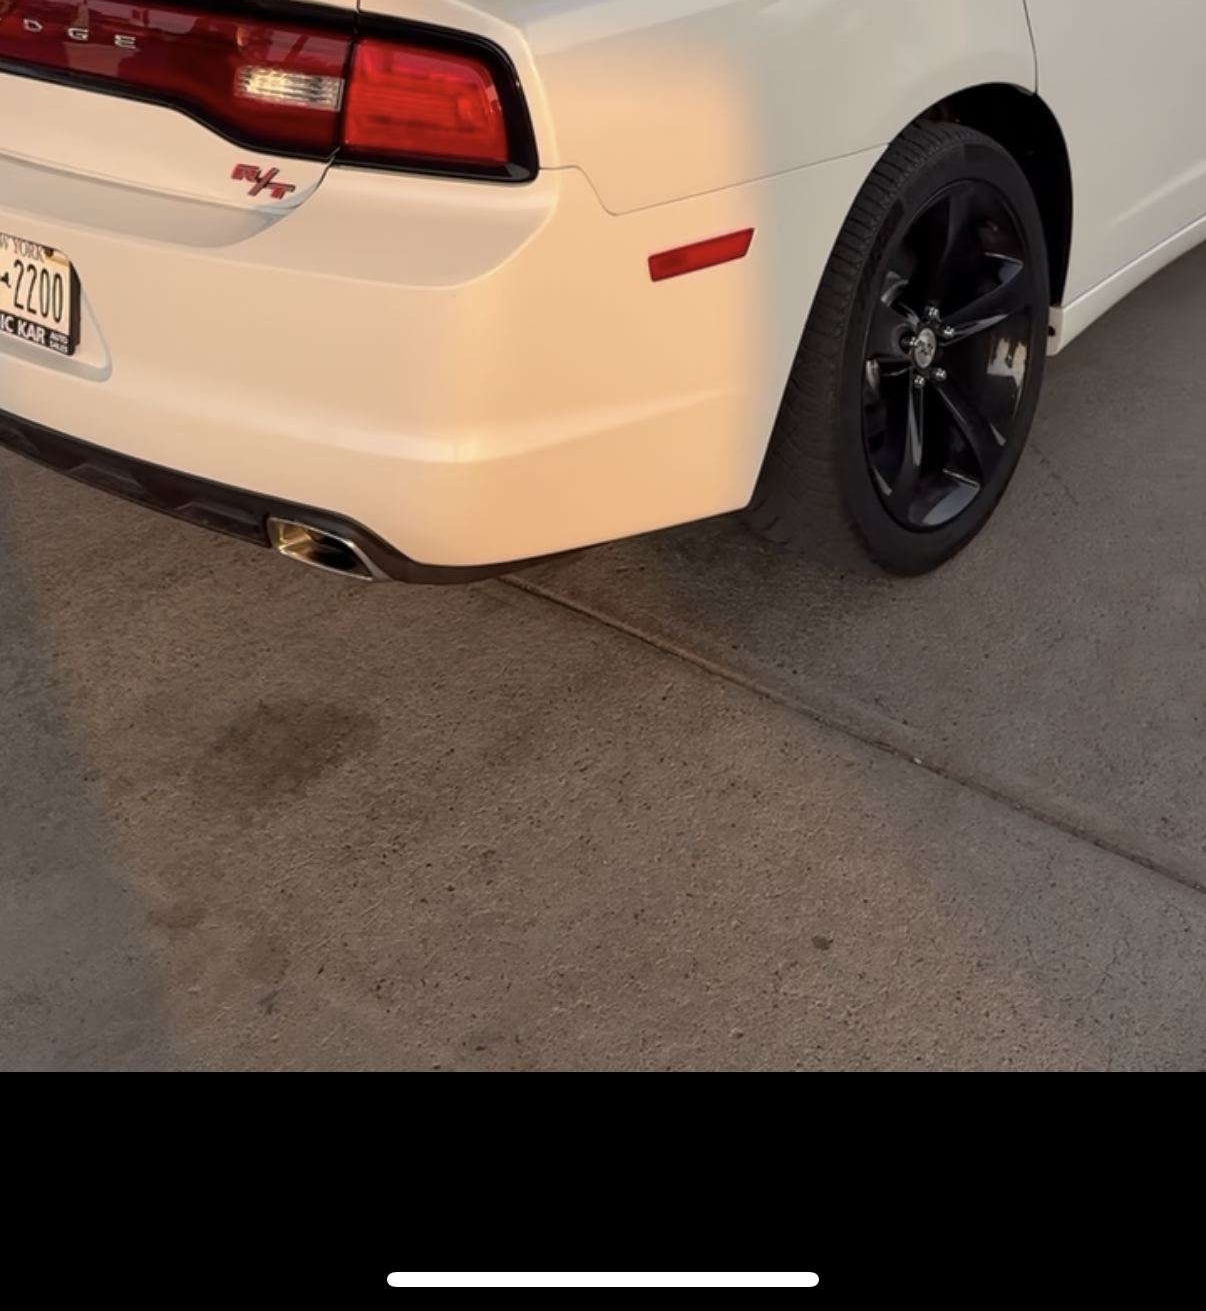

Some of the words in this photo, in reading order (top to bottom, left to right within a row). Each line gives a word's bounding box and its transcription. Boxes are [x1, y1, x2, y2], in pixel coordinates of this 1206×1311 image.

[231, 163, 296, 200] R/T
[13, 238, 45, 263] YORK
[14, 259, 63, 324] 2200
[18, 320, 45, 345] KAR
